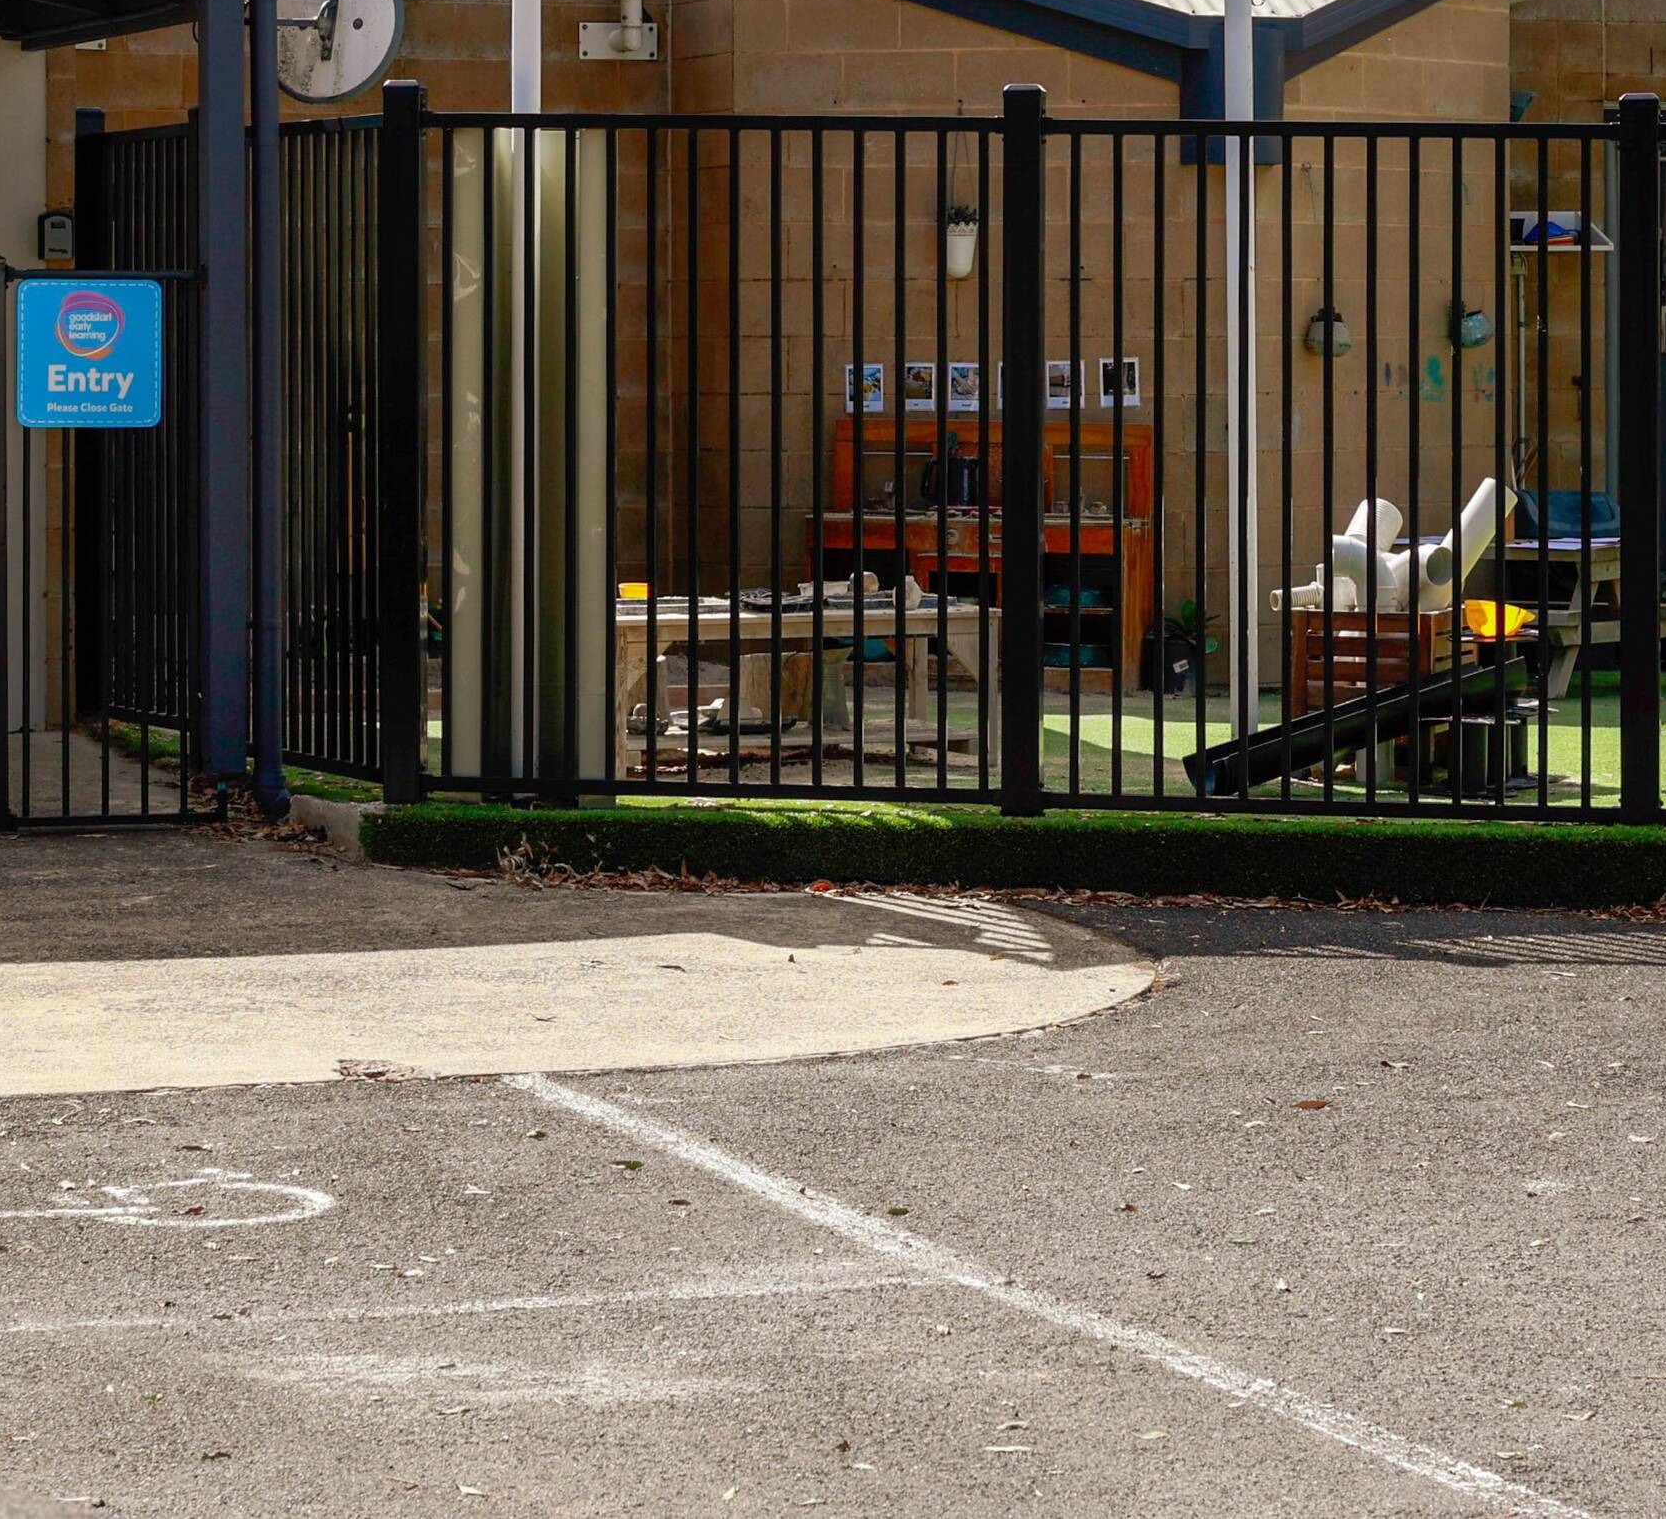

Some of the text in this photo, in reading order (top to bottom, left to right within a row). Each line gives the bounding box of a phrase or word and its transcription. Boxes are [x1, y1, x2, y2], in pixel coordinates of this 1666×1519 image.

[68, 312, 112, 323] goodstart
[68, 321, 92, 331] early
[68, 330, 106, 342] learning
[47, 364, 134, 399] Entry
[46, 402, 133, 412] Please Close Gate
